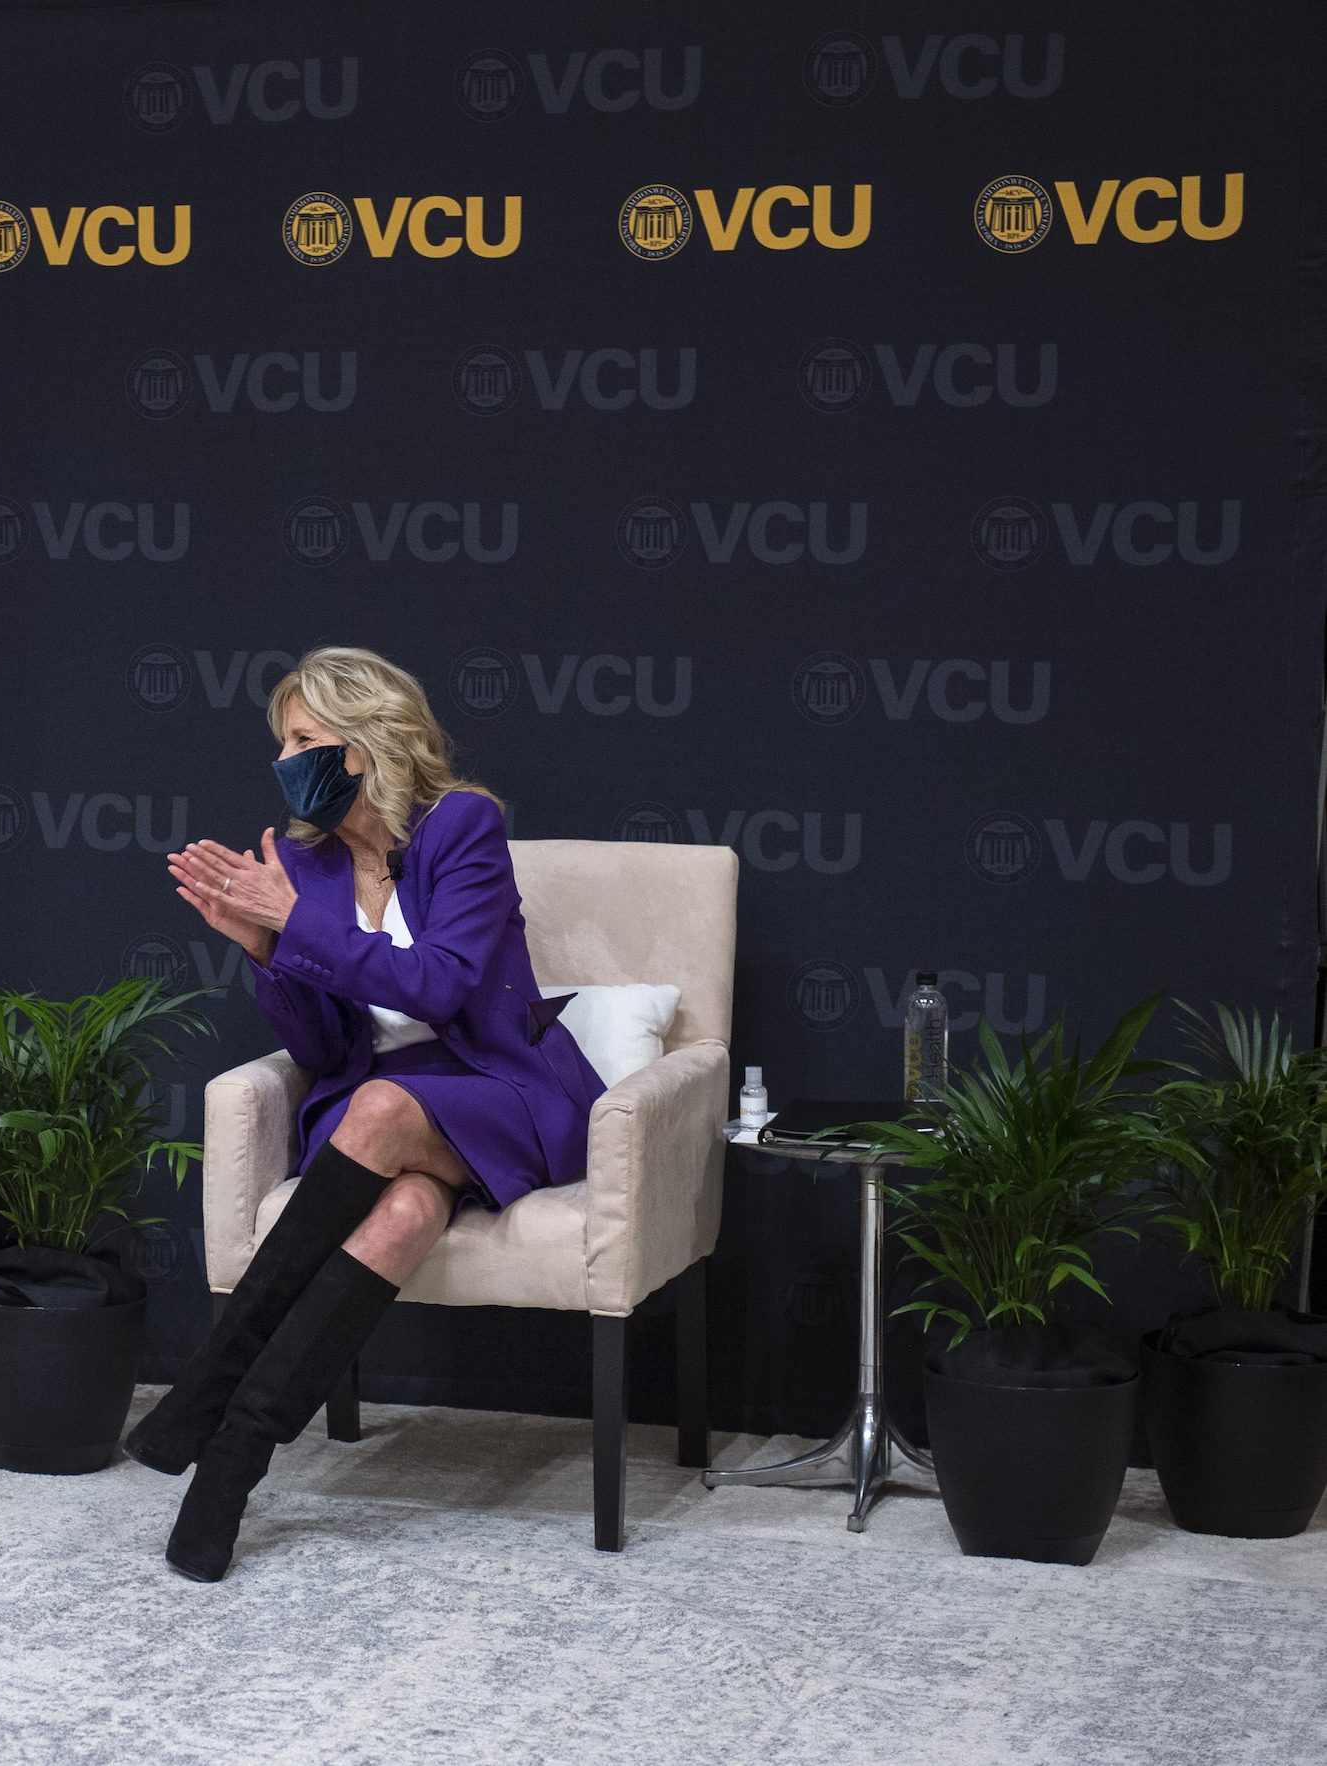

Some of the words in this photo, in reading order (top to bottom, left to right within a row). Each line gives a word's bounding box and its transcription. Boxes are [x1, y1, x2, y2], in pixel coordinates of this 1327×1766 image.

[192, 56, 358, 125] VCU
[527, 45, 701, 115] VCU
[879, 32, 1065, 100] VCU
[31, 204, 191, 267] VCU
[354, 195, 522, 258] VCU
[694, 184, 872, 250] VCU
[1054, 173, 1243, 245] VCU
[194, 351, 358, 413] VCU
[525, 347, 696, 411] VCU
[875, 342, 1058, 409] VCU
[32, 501, 190, 563] VCU
[353, 500, 519, 563] VCU
[690, 500, 868, 565] VCU
[1051, 499, 1241, 566] VCU
[194, 650, 298, 708] VC
[521, 653, 692, 717] VCU
[868, 657, 1051, 725] VCU
[30, 792, 188, 854] VCU
[685, 808, 862, 875] VCU
[1042, 818, 1232, 887] VCU
[863, 967, 1045, 1036] VCU
[907, 1033, 922, 1081] VCU
[925, 1019, 942, 1079] Health
